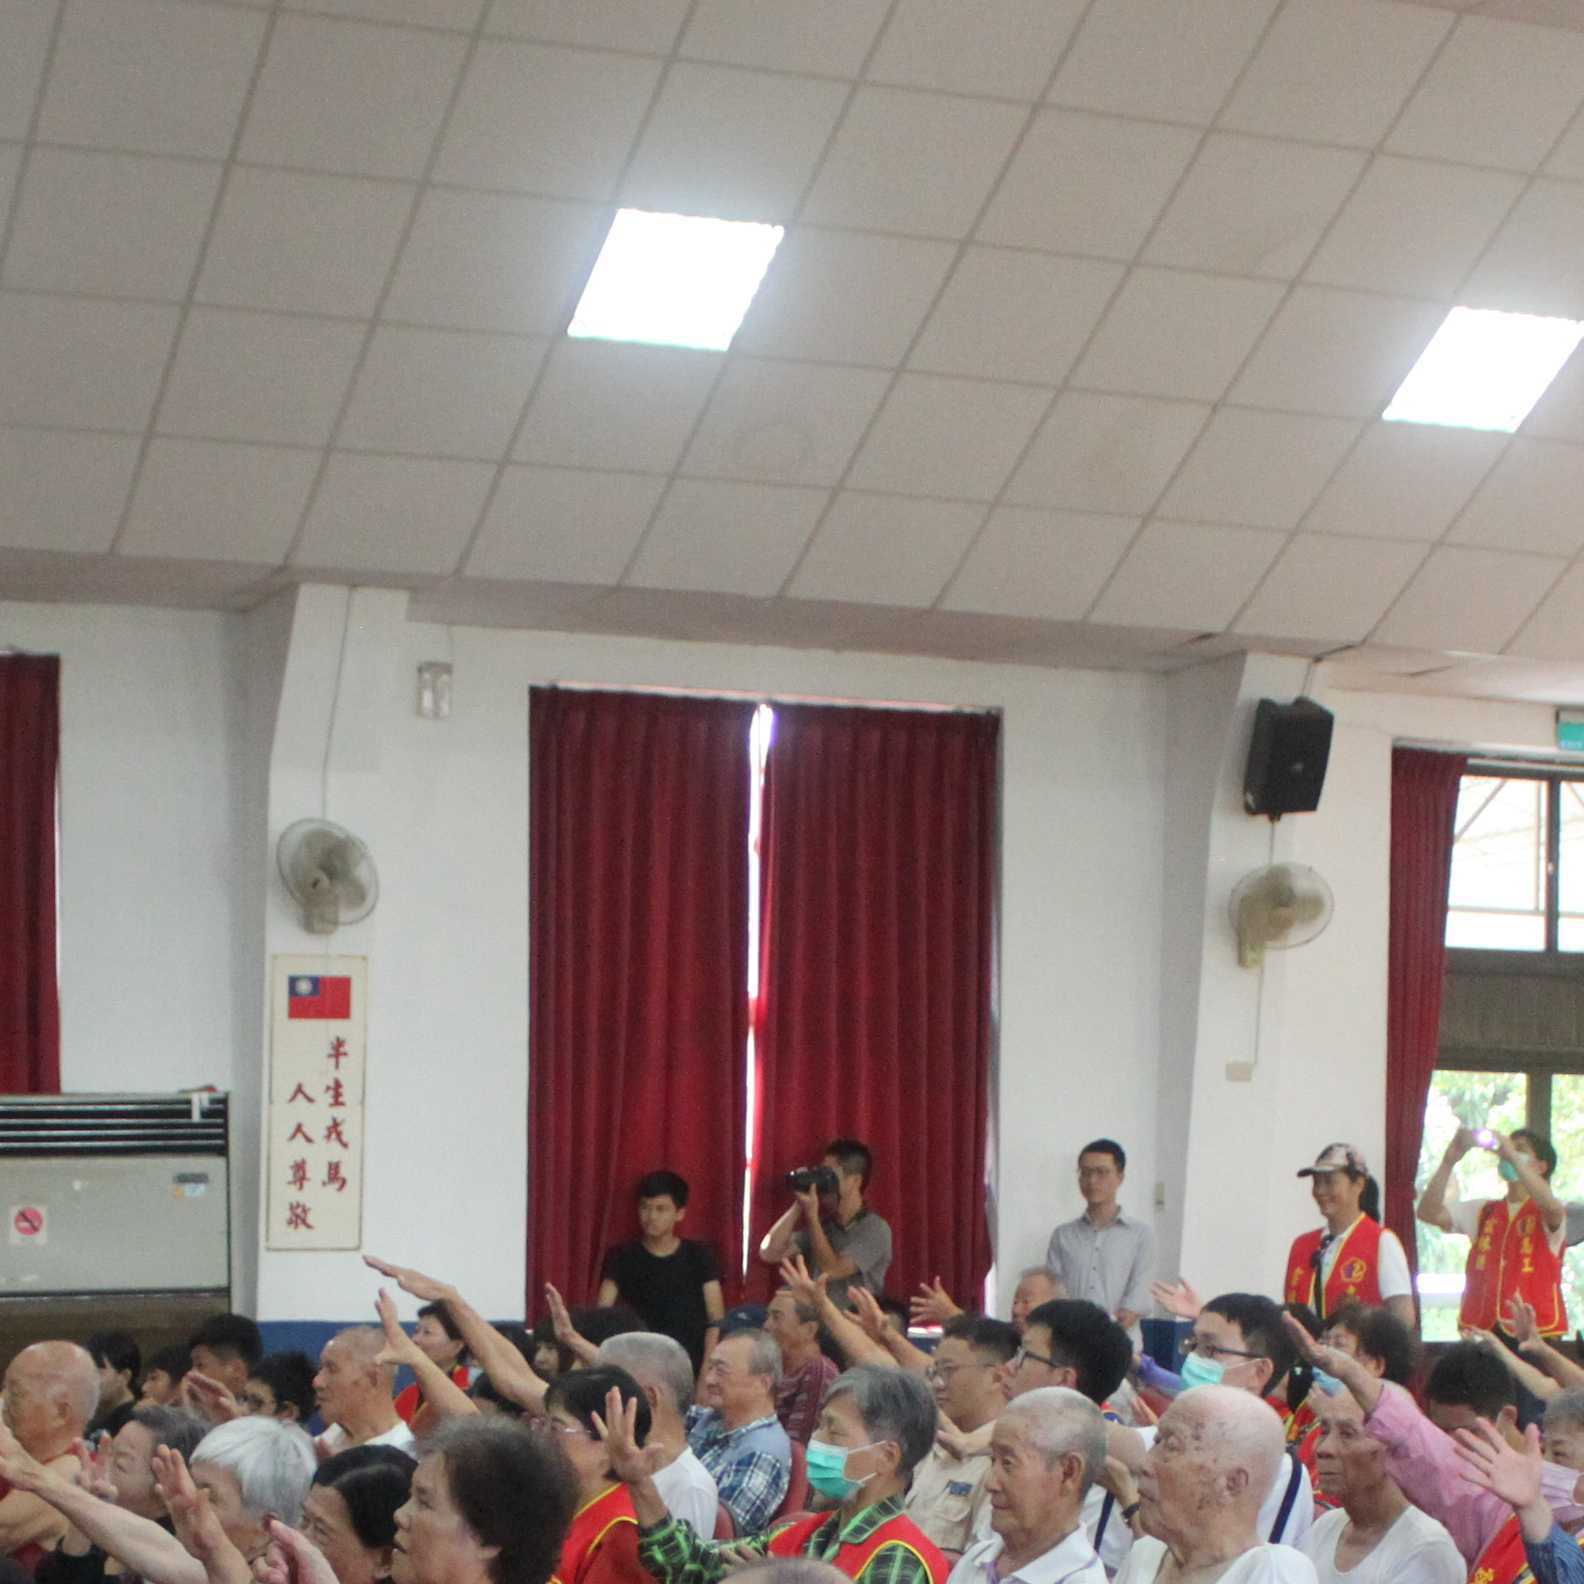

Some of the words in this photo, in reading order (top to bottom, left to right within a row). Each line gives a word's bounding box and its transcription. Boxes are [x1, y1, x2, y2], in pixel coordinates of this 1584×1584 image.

[287, 1082, 315, 1230] 人人尊敬
[322, 1036, 349, 1192] 半生戎馬
